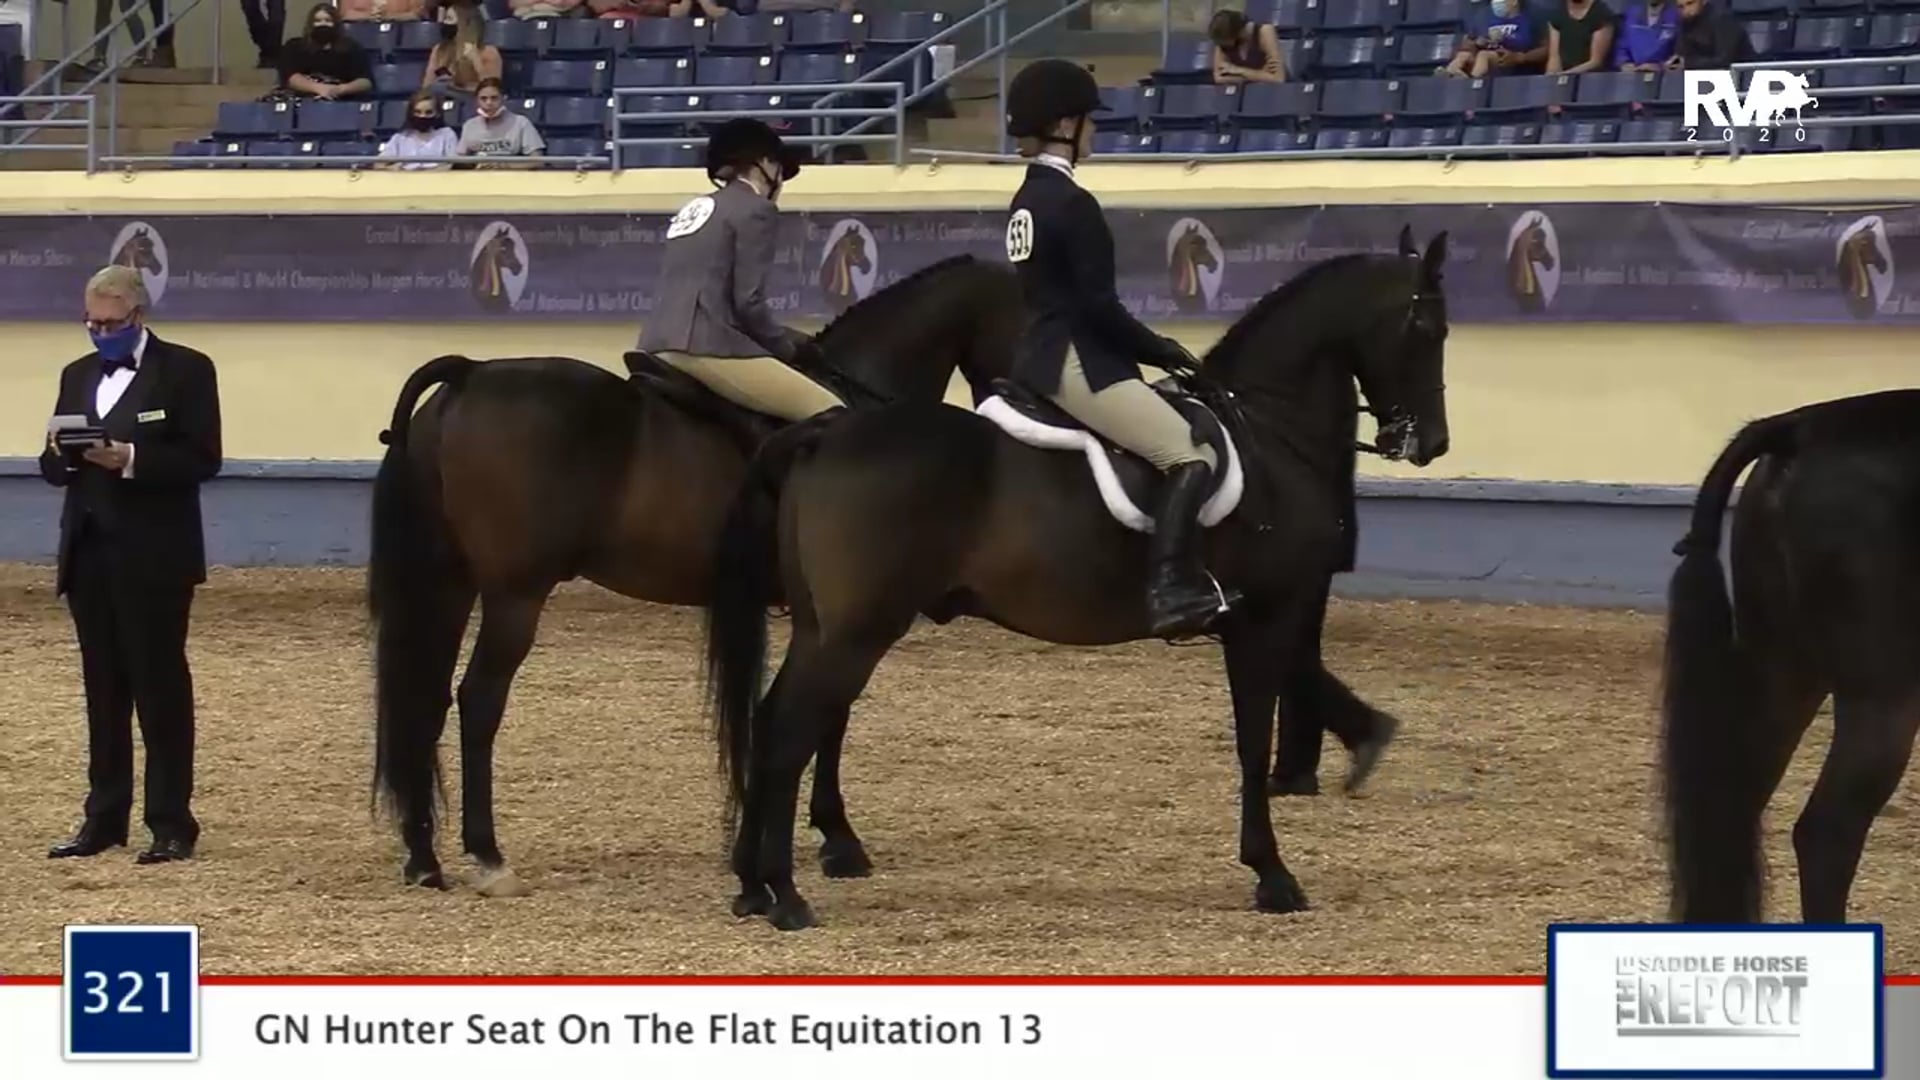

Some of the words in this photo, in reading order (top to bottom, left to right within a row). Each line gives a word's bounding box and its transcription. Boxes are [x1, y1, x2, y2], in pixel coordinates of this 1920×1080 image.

[1010, 216, 1030, 257] 551
[168, 270, 190, 288] and
[193, 270, 239, 288] National
[256, 270, 287, 288] World
[291, 270, 369, 294] Championship
[371, 272, 412, 294] Morgan
[415, 272, 445, 288] Horse
[448, 270, 473, 288] Sho
[598, 291, 629, 311] World
